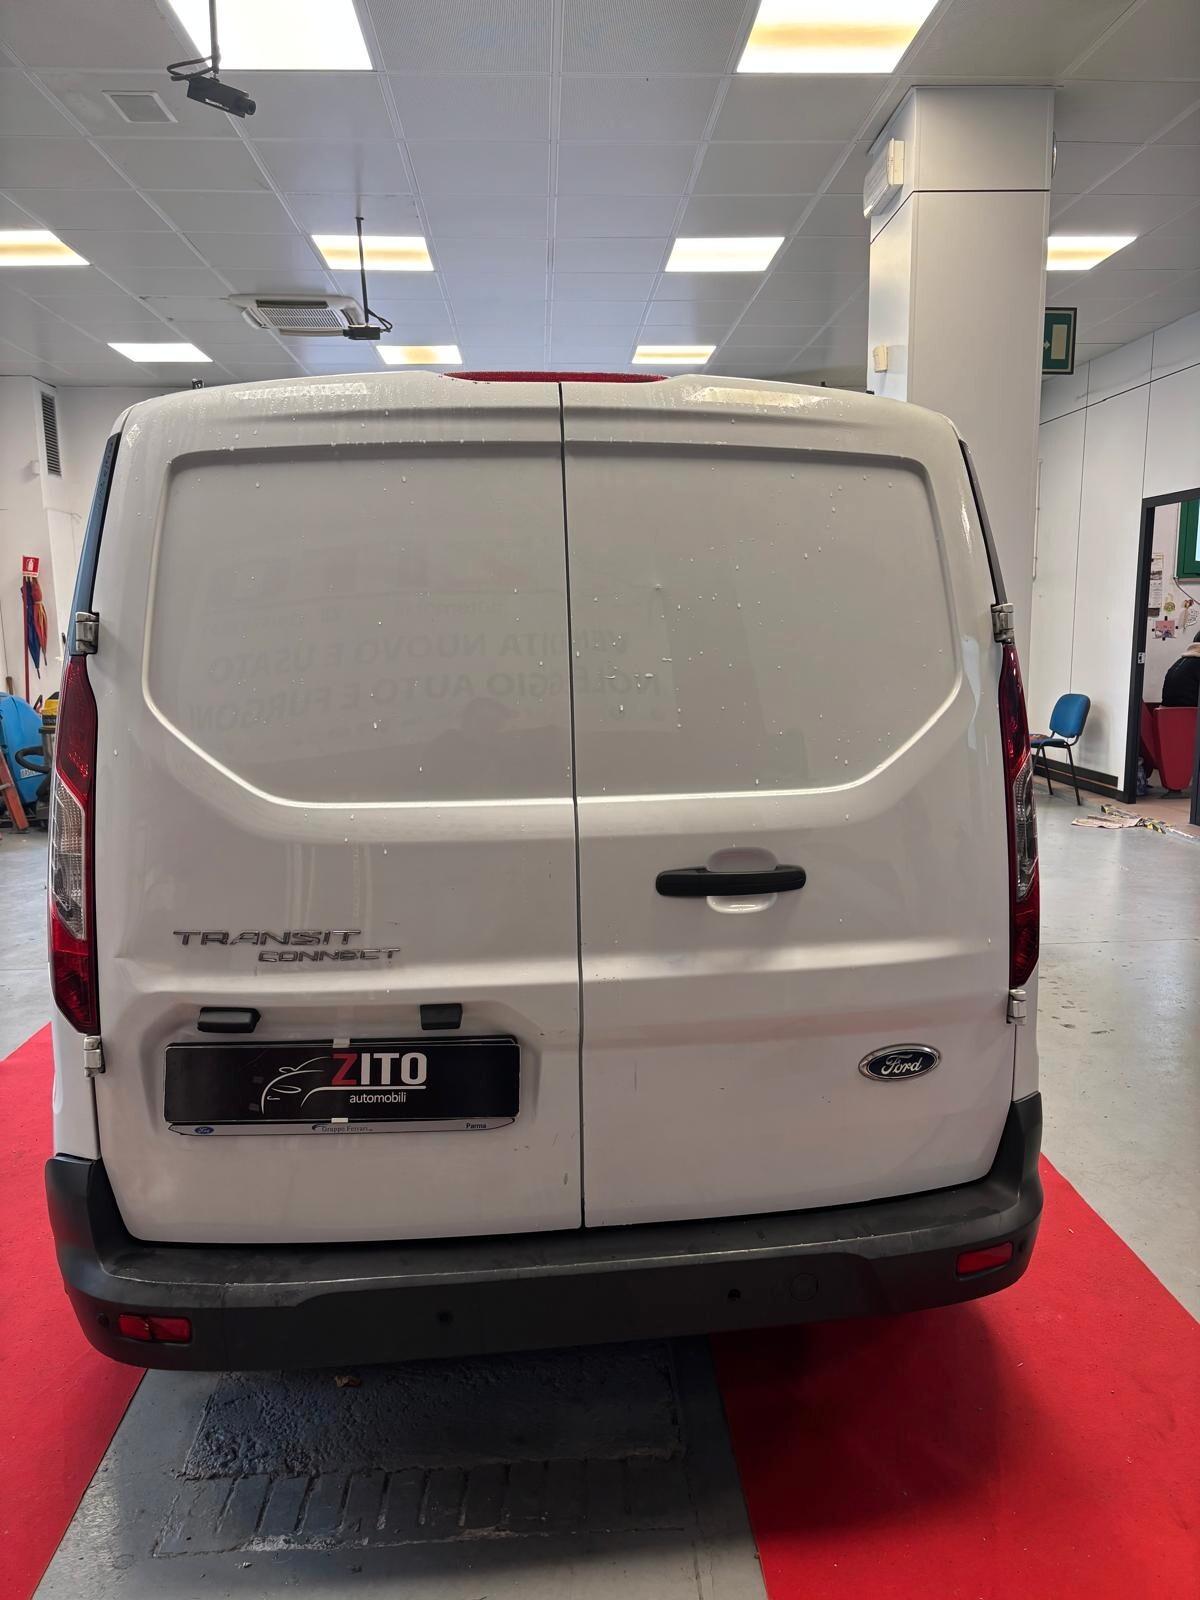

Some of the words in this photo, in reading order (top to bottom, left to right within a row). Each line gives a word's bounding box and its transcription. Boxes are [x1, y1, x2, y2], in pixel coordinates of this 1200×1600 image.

[172, 929, 362, 946] TRANSIT
[257, 946, 401, 963] CONNECT
[331, 1051, 428, 1086] ZITO
[881, 1054, 923, 1076] Ford
[349, 1091, 407, 1104] automobili
[465, 1122, 487, 1130] Parma
